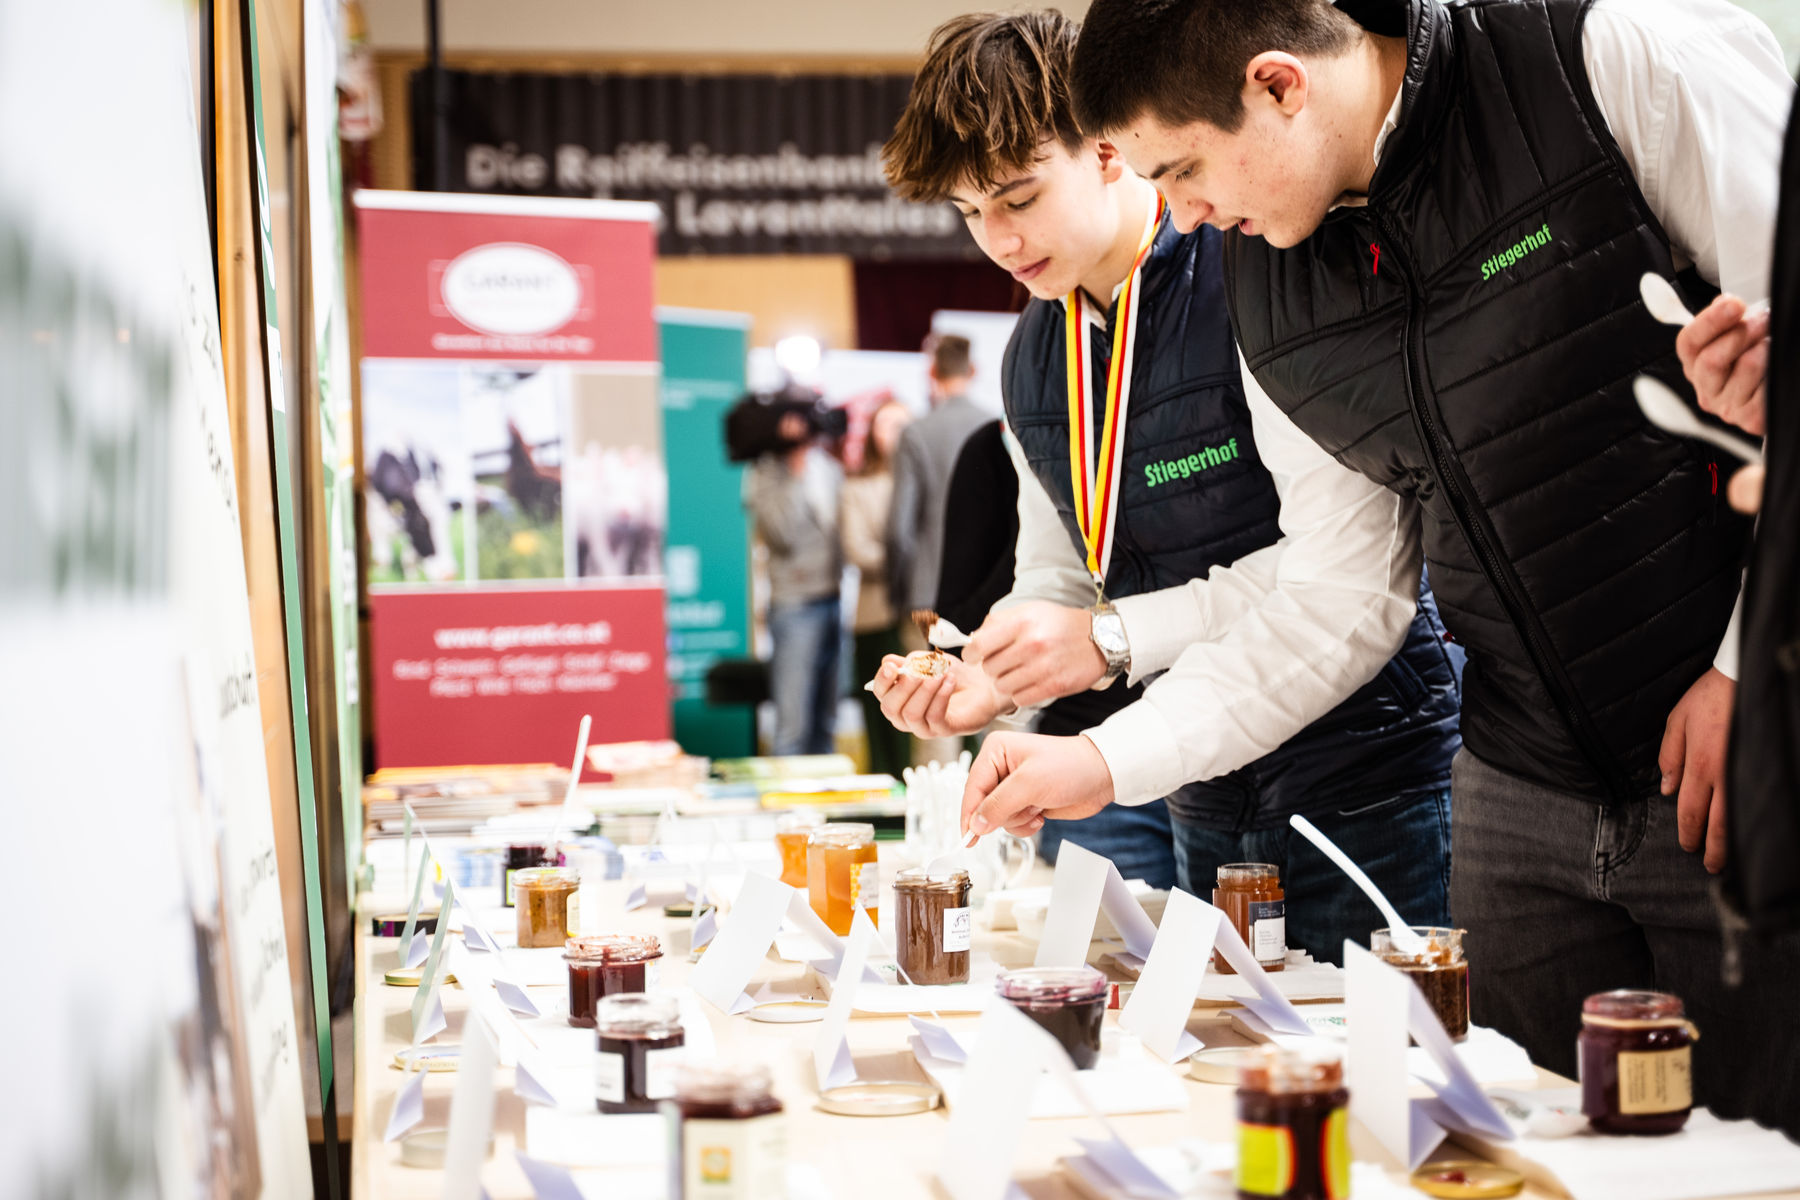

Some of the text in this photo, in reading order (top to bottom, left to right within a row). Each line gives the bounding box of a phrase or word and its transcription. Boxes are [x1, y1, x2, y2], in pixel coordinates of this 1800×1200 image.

[466, 143, 548, 188] Die
[1481, 224, 1552, 280] Stiegerhof
[1144, 438, 1238, 487] Stiegerhof
